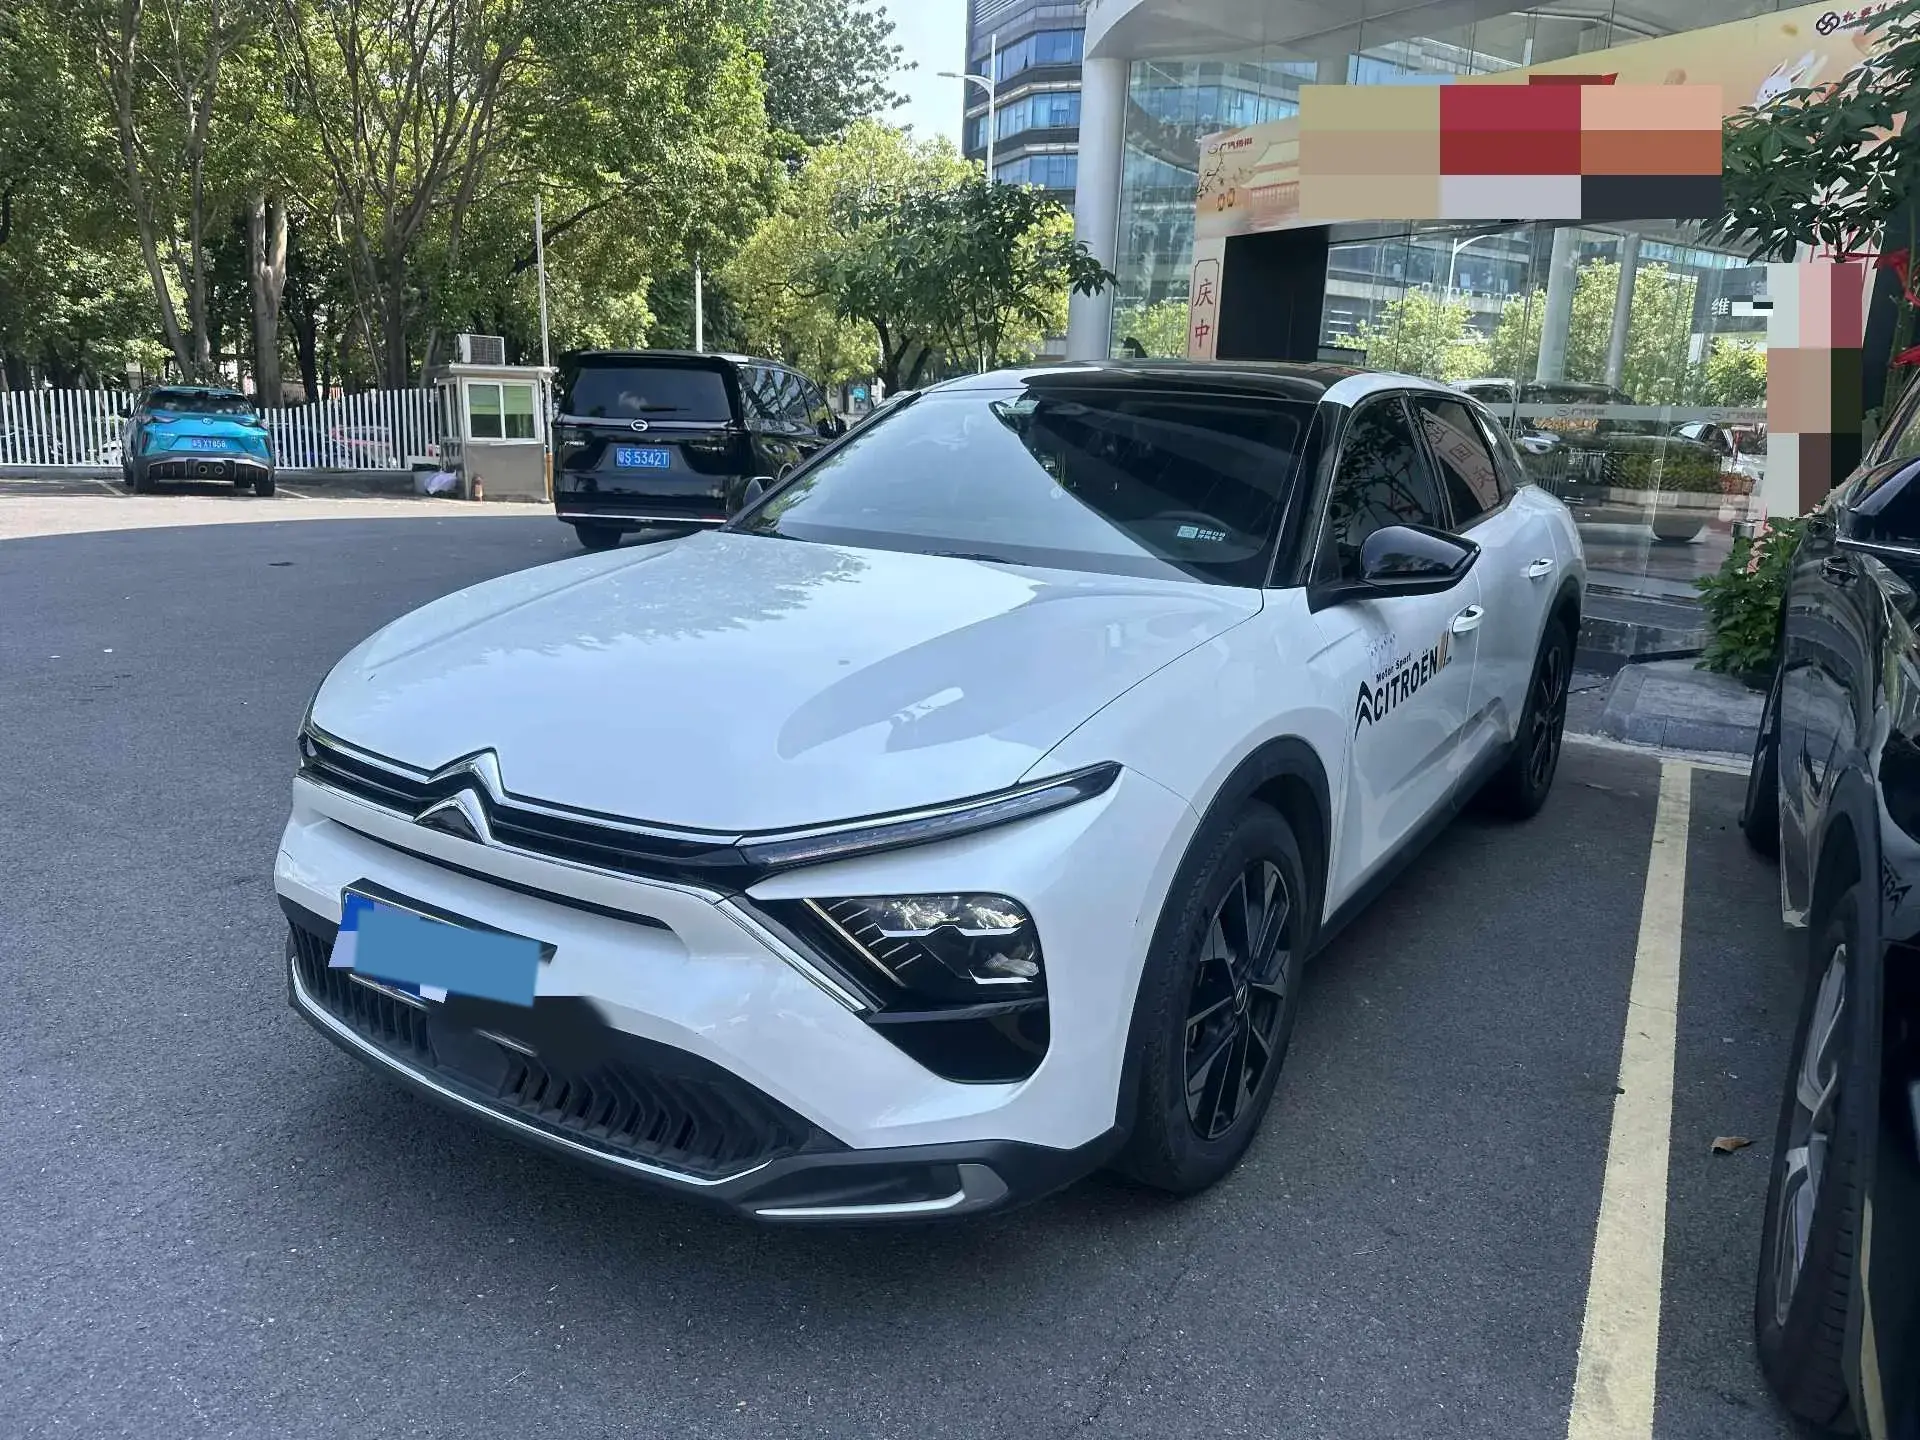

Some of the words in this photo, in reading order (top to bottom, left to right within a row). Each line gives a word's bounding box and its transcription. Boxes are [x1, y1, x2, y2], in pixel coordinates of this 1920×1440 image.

[1374, 646, 1438, 721] CITROËN
[1376, 666, 1394, 683] Motor
[1396, 652, 1411, 670] Sport
